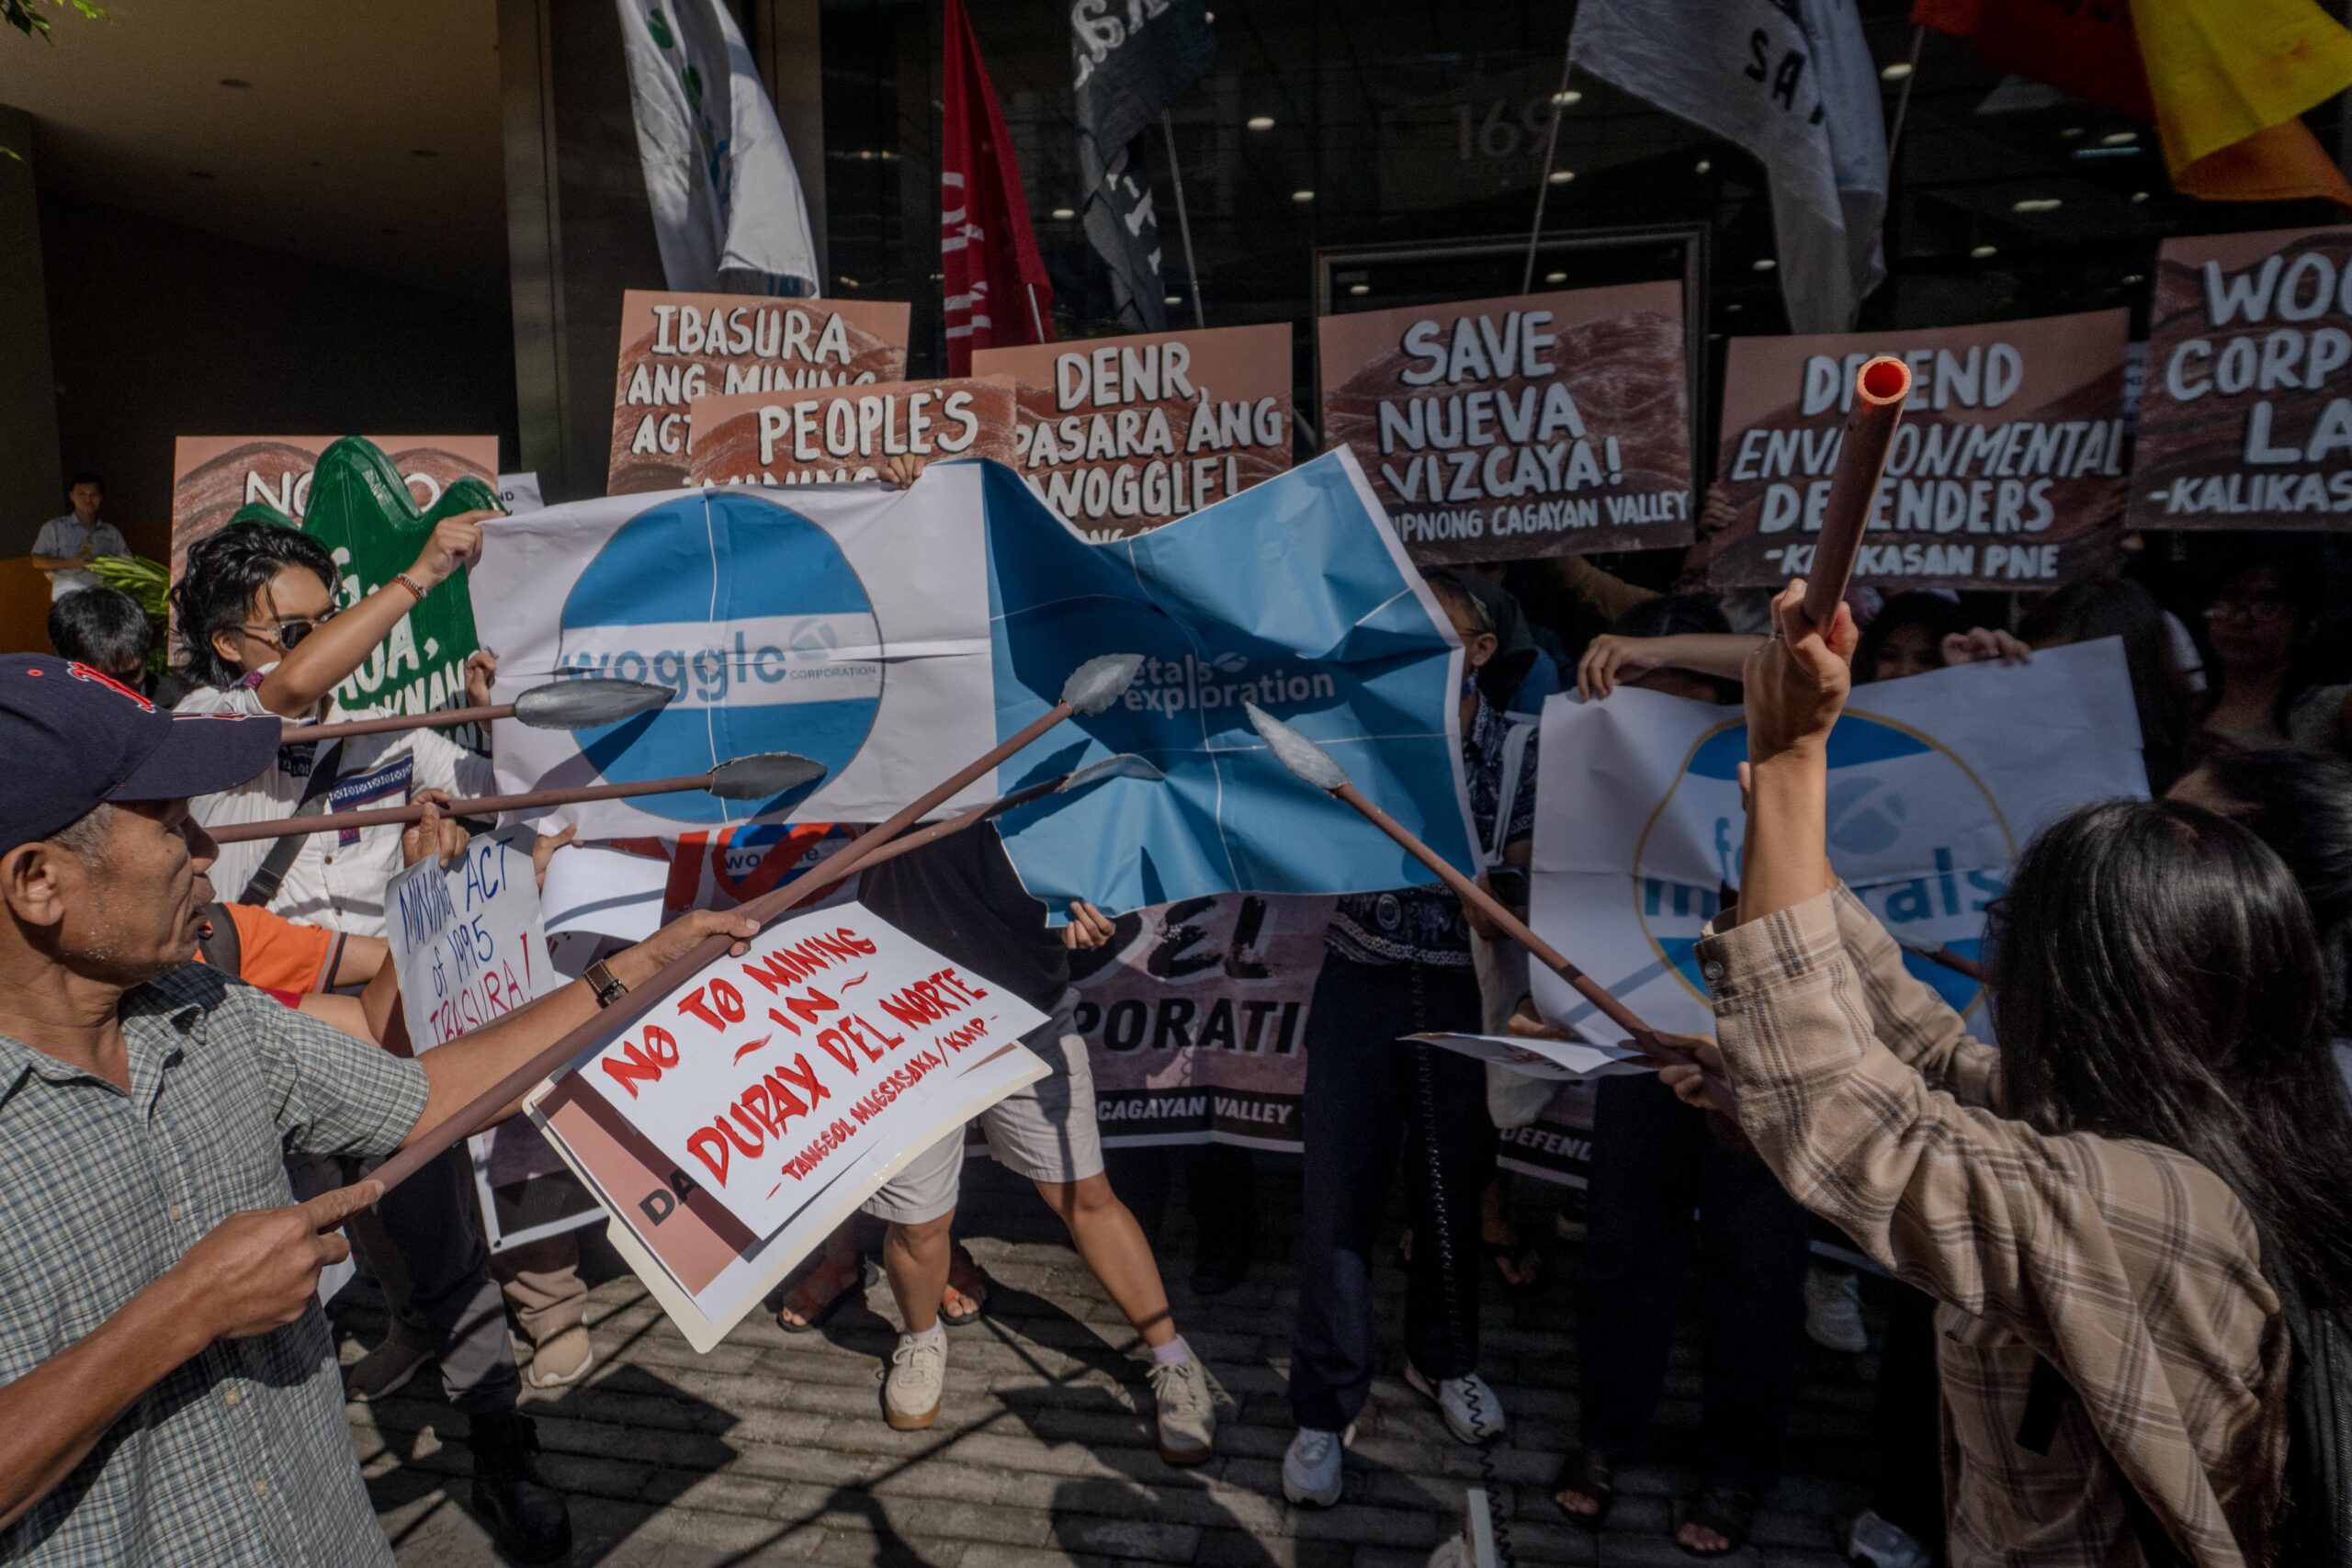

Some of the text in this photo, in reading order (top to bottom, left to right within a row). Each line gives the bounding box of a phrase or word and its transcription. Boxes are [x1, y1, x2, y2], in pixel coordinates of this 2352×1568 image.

[2206, 252, 2352, 327] WO
[650, 305, 851, 365] IBASURA
[1399, 310, 1556, 386] SAVE
[627, 364, 706, 406] ANG
[631, 413, 691, 455] AC
[758, 390, 979, 466] PEOPLE'S
[1186, 397, 1283, 456] ANG
[1379, 382, 1588, 456] NUEVA
[1381, 435, 1623, 504] VIZCAYA!
[1730, 419, 2124, 481] ENVIONMENTAL
[1492, 499, 1599, 536] CAGAYAN
[1604, 491, 1689, 525] VALLEY
[1758, 477, 2055, 534] DEENDERS
[1983, 544, 2061, 578] PNE
[789, 665, 876, 680] CORPORATION
[1124, 669, 1335, 719] exploration
[467, 836, 514, 911] ACT
[433, 945, 448, 998] of
[447, 913, 493, 984] 1995
[741, 927, 877, 995] MINING
[686, 1052, 831, 1189] DUPAX
[816, 1013, 905, 1076] DEL
[1097, 1096, 1294, 1124] CAGAYAN VALLEY
